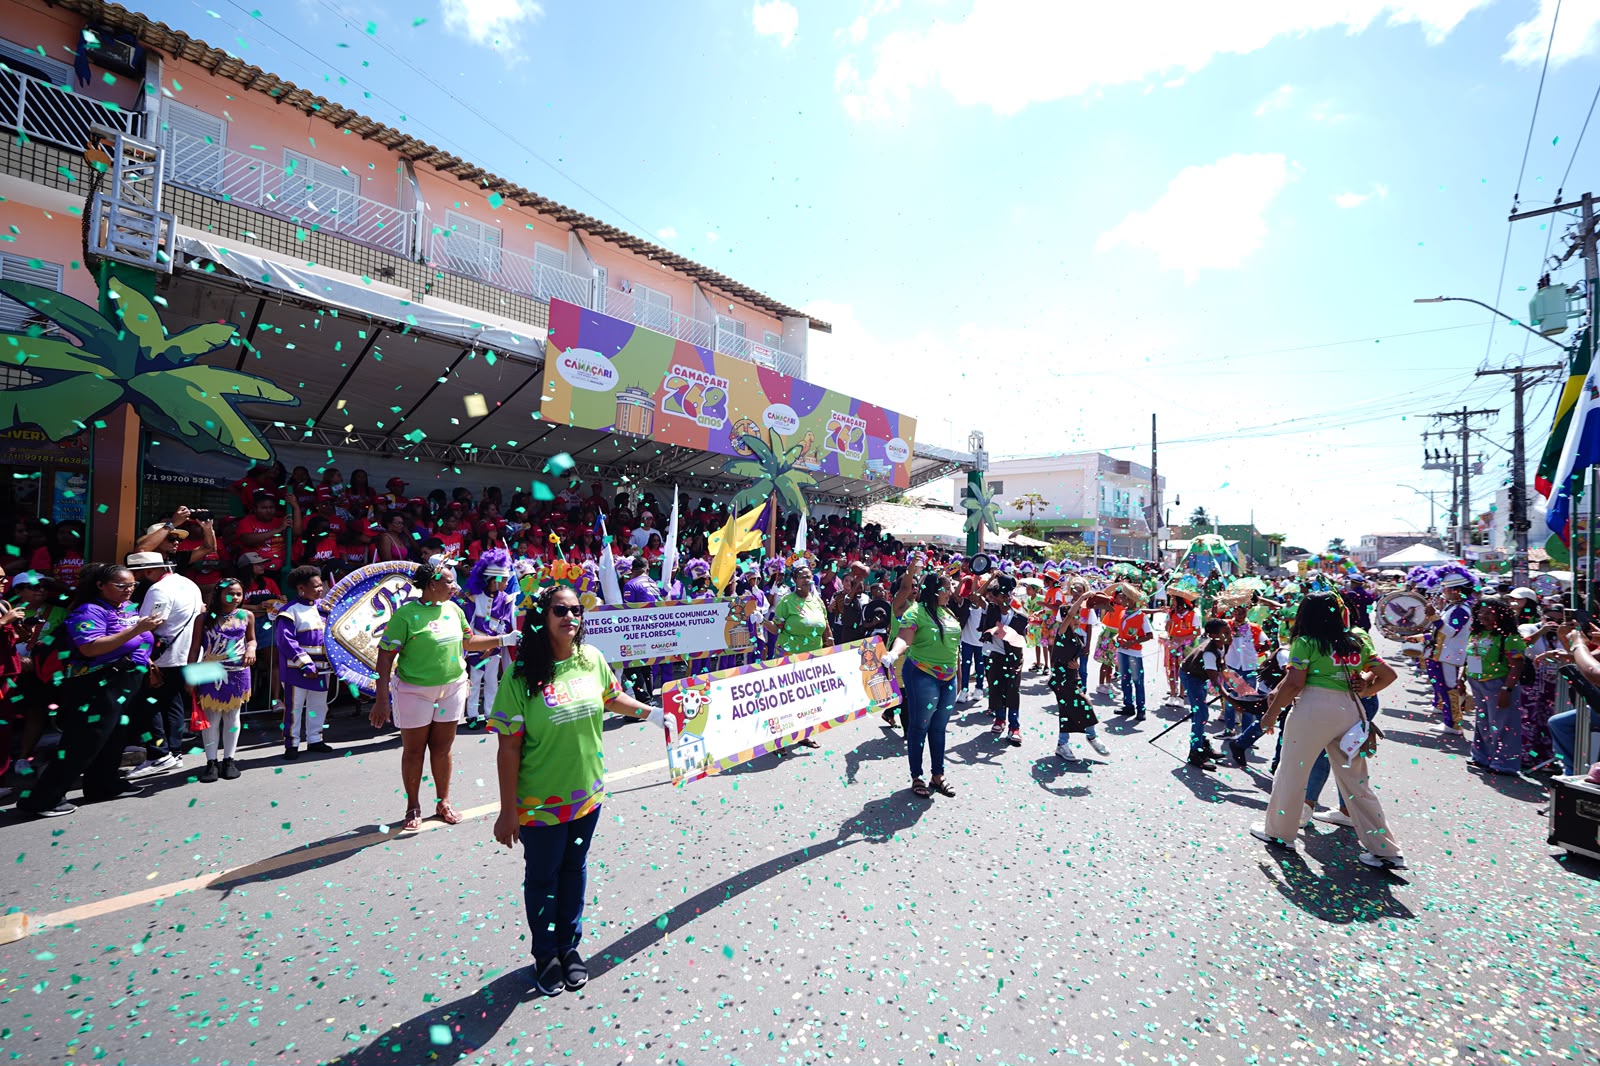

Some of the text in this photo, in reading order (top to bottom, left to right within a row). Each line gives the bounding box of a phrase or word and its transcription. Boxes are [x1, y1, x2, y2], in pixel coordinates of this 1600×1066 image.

[564, 358, 612, 378] CAMAÇARI
[674, 367, 728, 389] CAMAÇARI
[663, 376, 727, 420] 268
[697, 415, 722, 428] anos
[767, 412, 796, 425] CAMAÇARI
[832, 413, 866, 428] CAMAÇARI
[825, 420, 865, 453] 268
[192, 477, 215, 485] 5326
[583, 617, 716, 636] ABERES QUE TRANSFORMAM, FUTURO
[601, 617, 632, 626] GODO:
[632, 614, 658, 623] RAIZES
[658, 613, 674, 621] QUE
[674, 609, 720, 620] COMUNICAM,
[623, 629, 677, 641] QUE FLORESCE
[730, 663, 836, 701] ESCOLA MUNICIPAL
[779, 690, 796, 706] DE
[796, 678, 846, 700] OLIVEIRA
